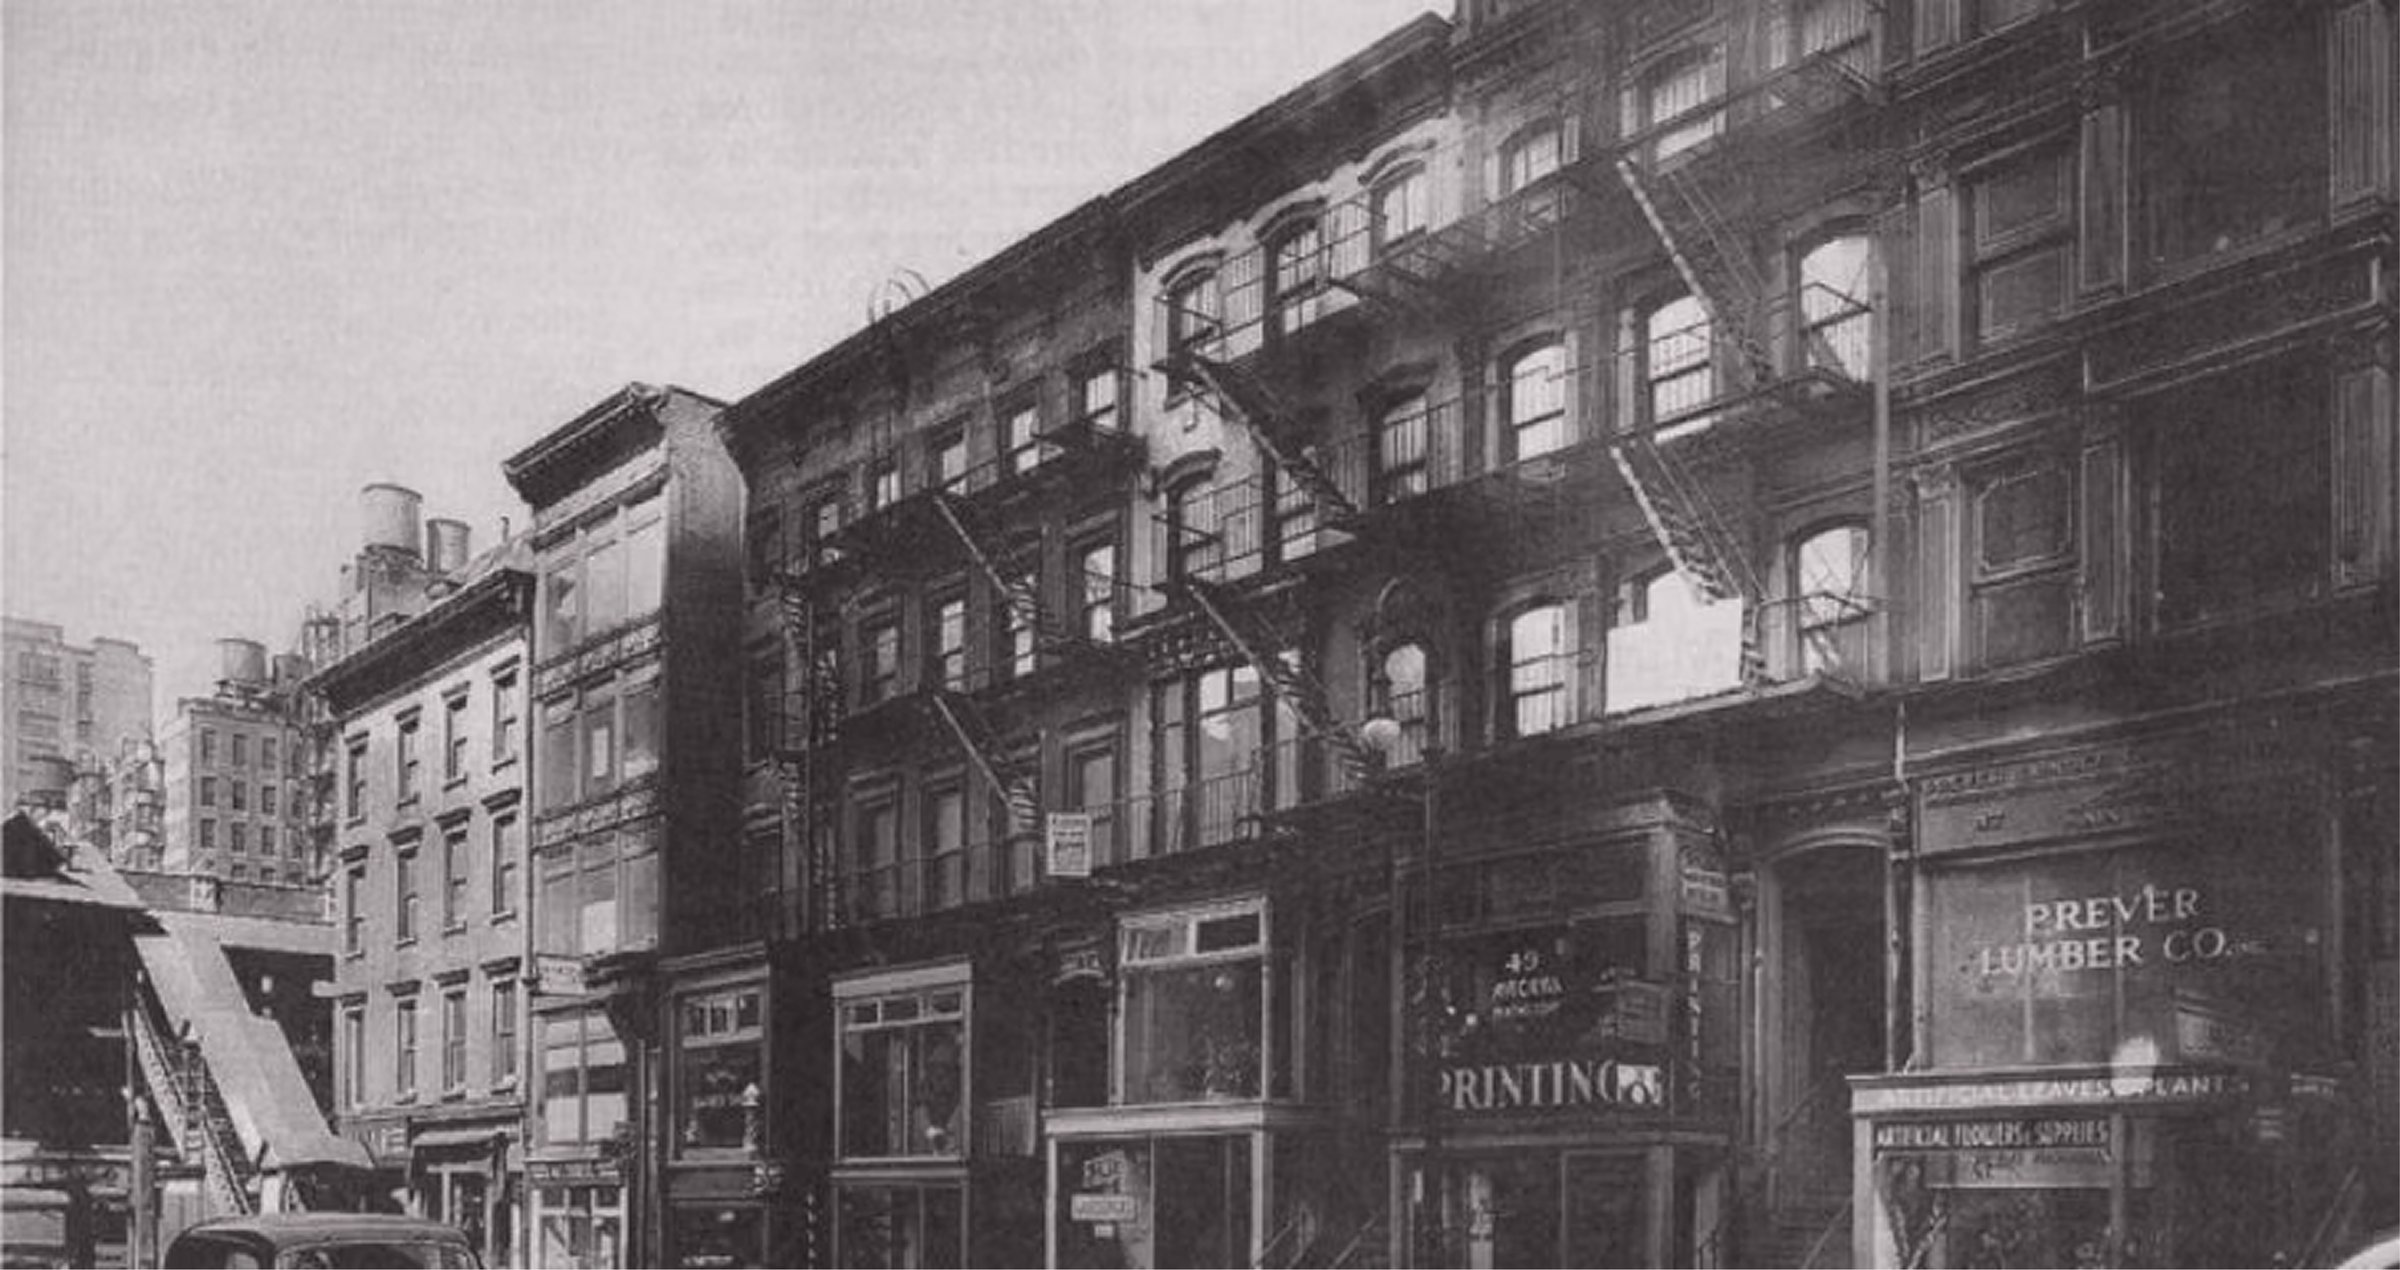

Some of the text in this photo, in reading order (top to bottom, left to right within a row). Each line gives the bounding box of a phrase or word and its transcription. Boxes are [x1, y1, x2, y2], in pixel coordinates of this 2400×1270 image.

[2025, 886, 2200, 932] PREVER
[1505, 950, 1540, 973] 49
[1980, 936, 2143, 976] LUMBER
